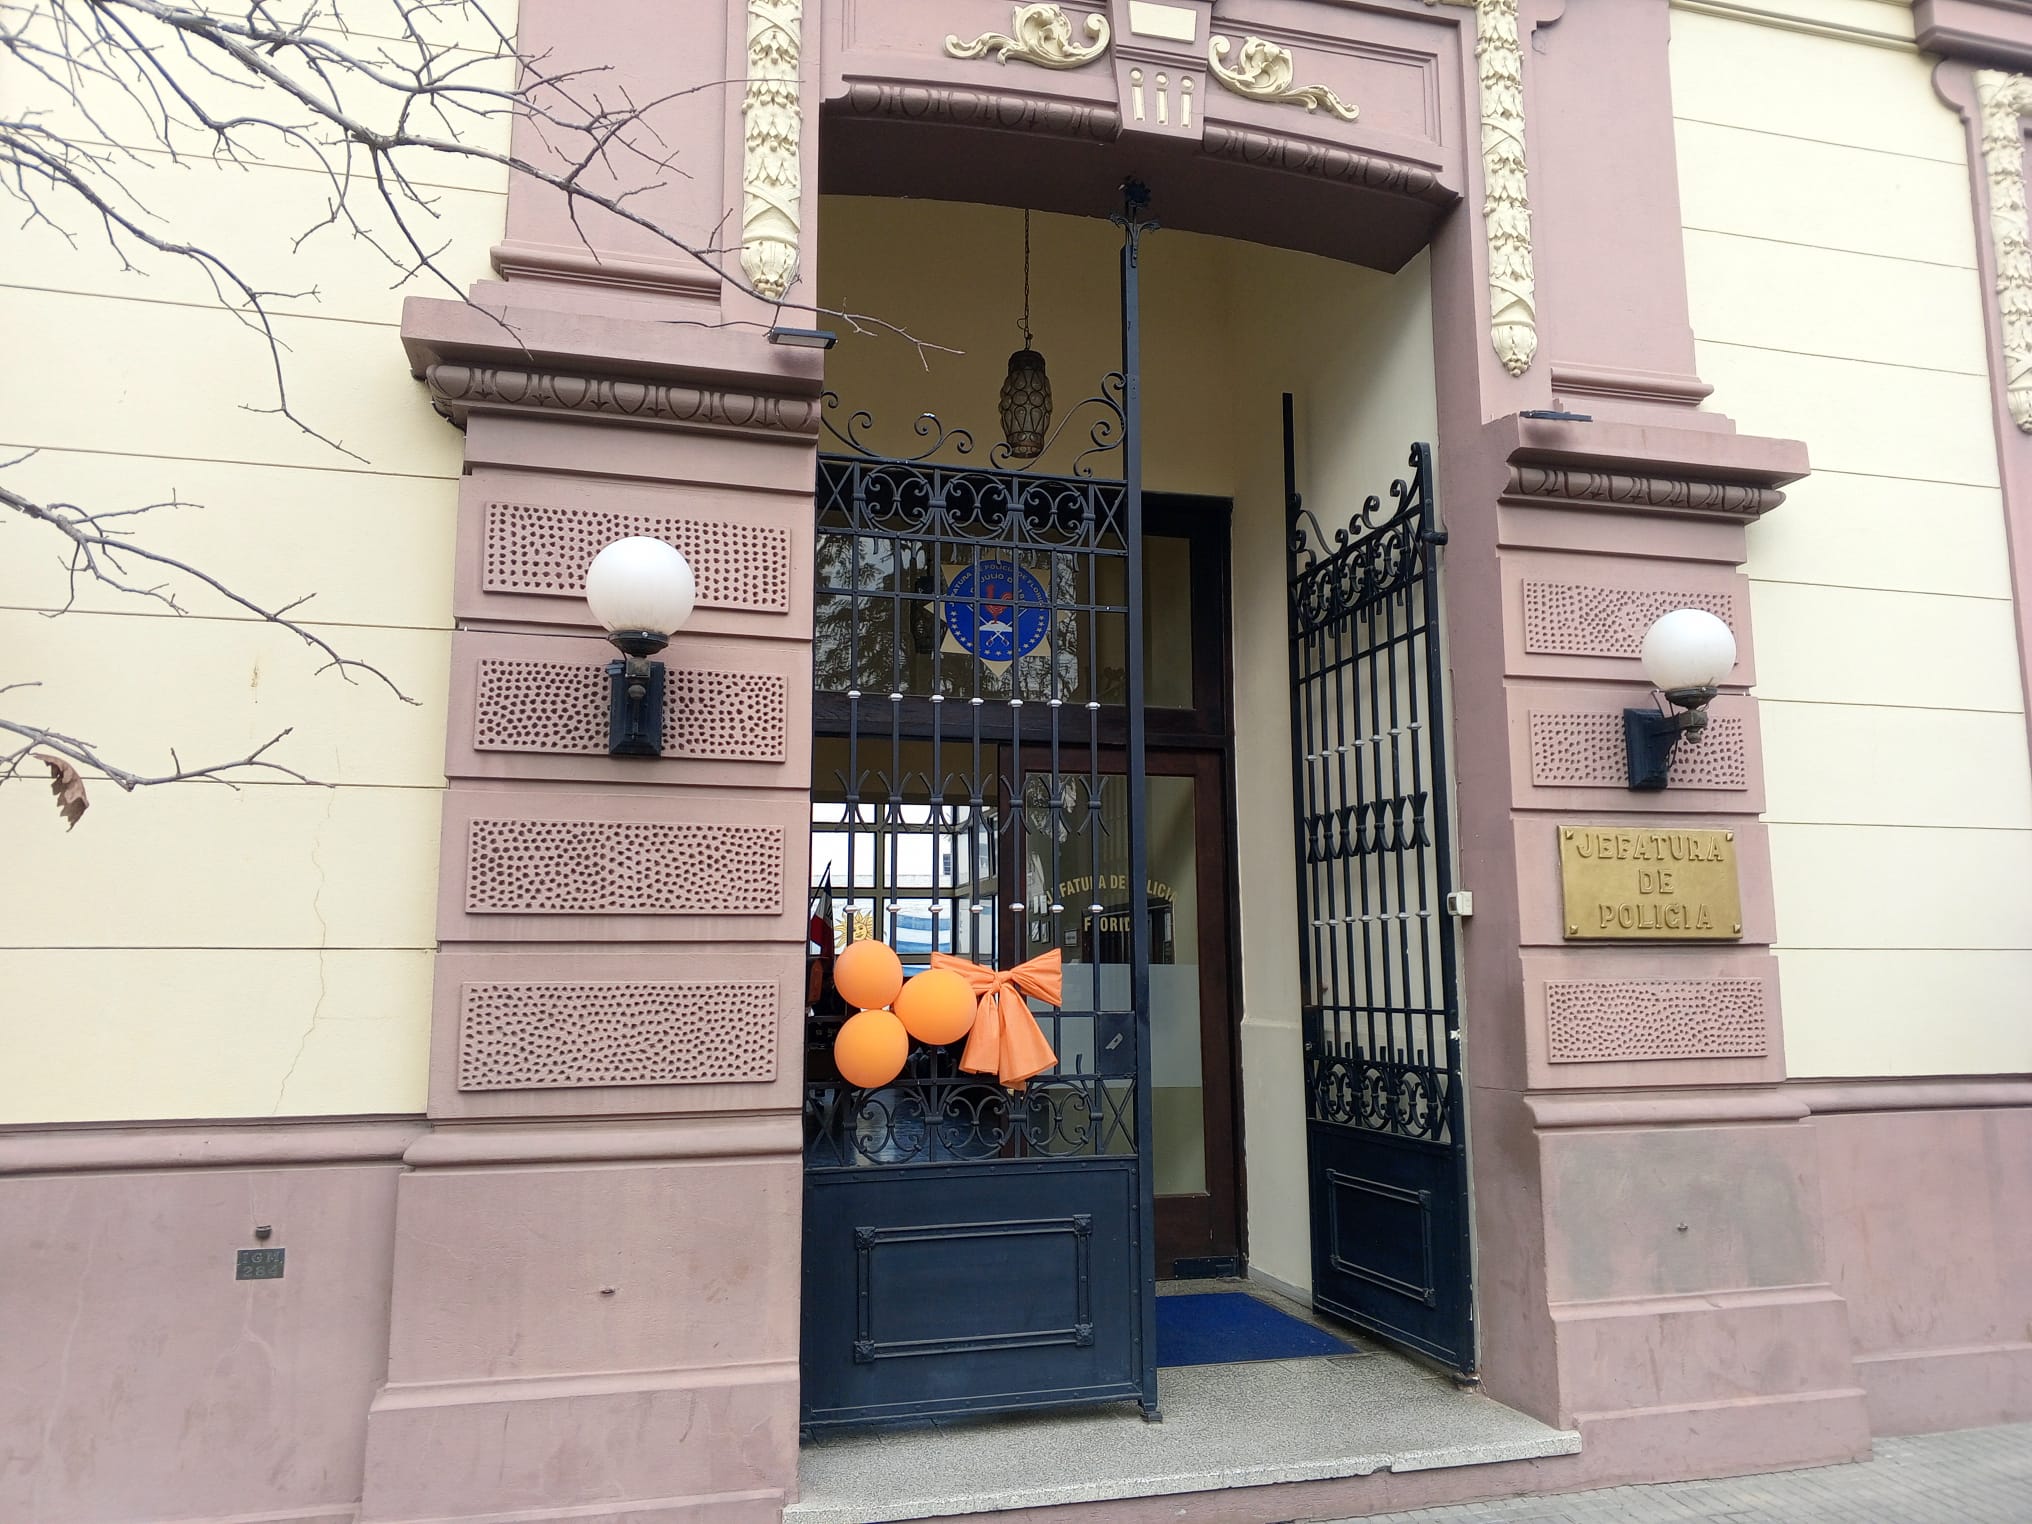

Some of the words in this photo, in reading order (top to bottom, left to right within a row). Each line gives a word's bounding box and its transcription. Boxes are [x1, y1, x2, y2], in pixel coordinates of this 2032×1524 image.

[1576, 833, 1724, 862] JEFATURA
[1046, 875, 1106, 905] JFATUA
[1110, 875, 1126, 889] DE
[1146, 880, 1177, 902] LICIA
[1638, 868, 1674, 895] DE
[1084, 916, 1131, 932] FORID
[1599, 903, 1713, 929] POLICIA
